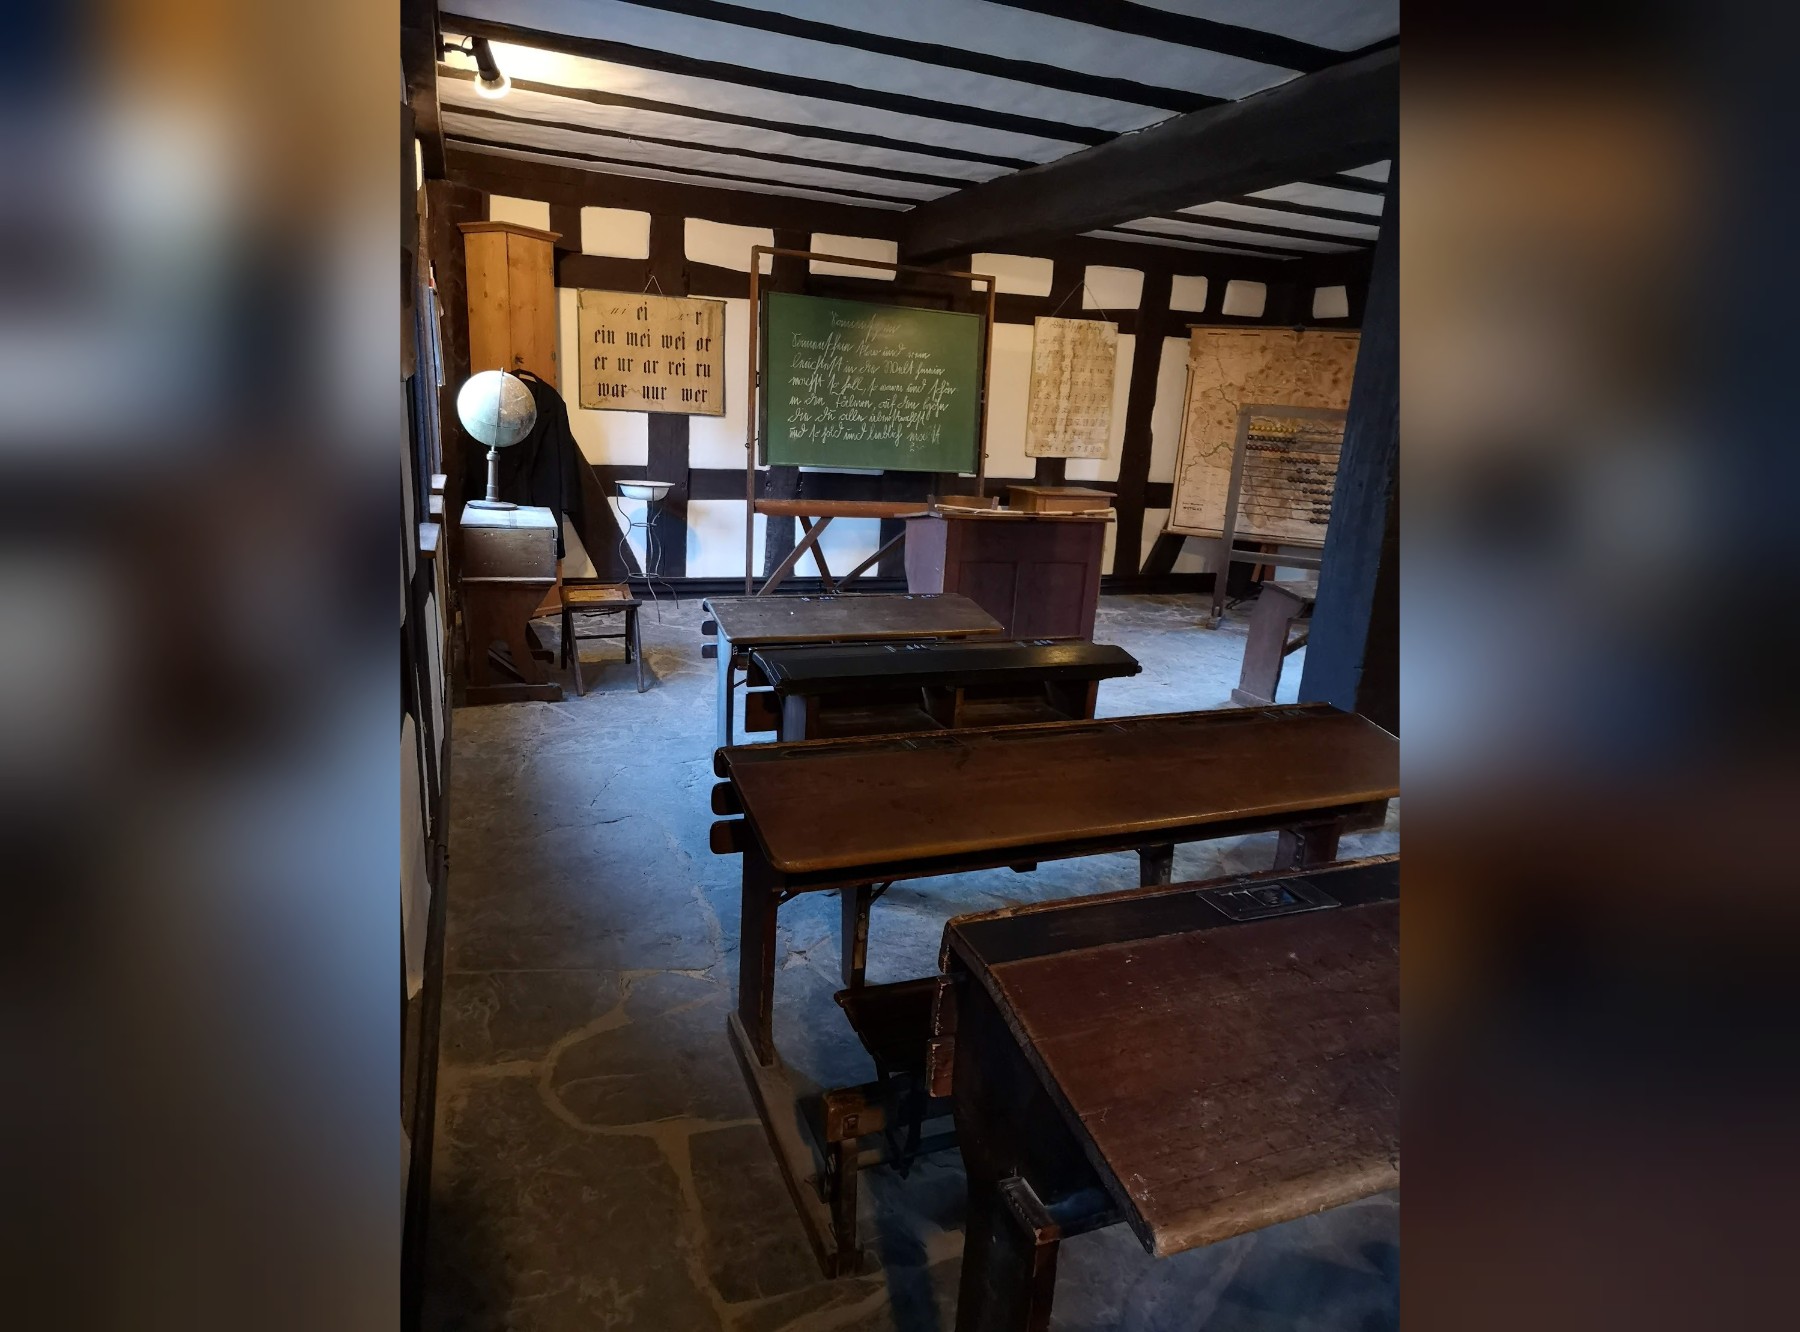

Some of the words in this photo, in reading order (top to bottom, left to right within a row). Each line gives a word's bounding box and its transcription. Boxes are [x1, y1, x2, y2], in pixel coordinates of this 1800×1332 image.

[637, 301, 648, 321] ei
[695, 311, 703, 325] r
[594, 324, 616, 345] ein
[626, 328, 651, 348] mei
[661, 331, 686, 351] wei
[696, 337, 712, 352] or
[594, 355, 608, 371] er
[617, 357, 634, 373] ur
[643, 359, 659, 374] ar
[668, 357, 686, 376] rei
[696, 362, 711, 378] ru
[597, 382, 627, 398] war
[642, 385, 667, 401] nur
[681, 387, 708, 403] wer
